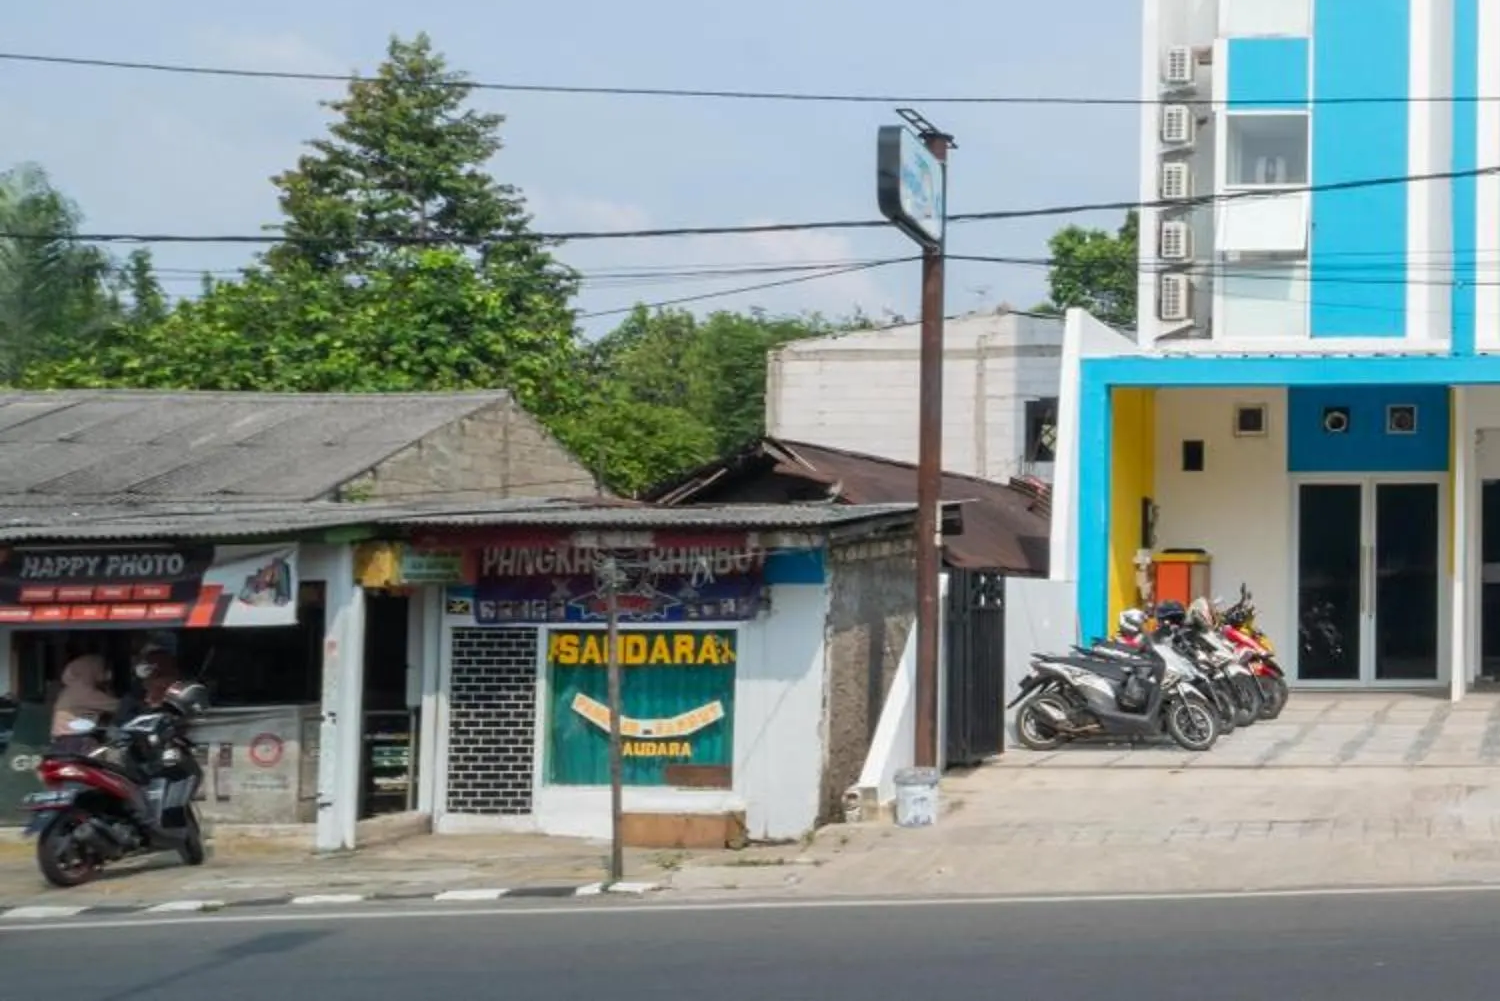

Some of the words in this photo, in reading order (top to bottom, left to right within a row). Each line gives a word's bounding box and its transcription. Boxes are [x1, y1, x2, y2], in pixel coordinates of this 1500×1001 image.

[20, 555, 101, 579] HAPPY
[105, 552, 185, 577] PHOTO
[622, 741, 692, 758] AUDARA
